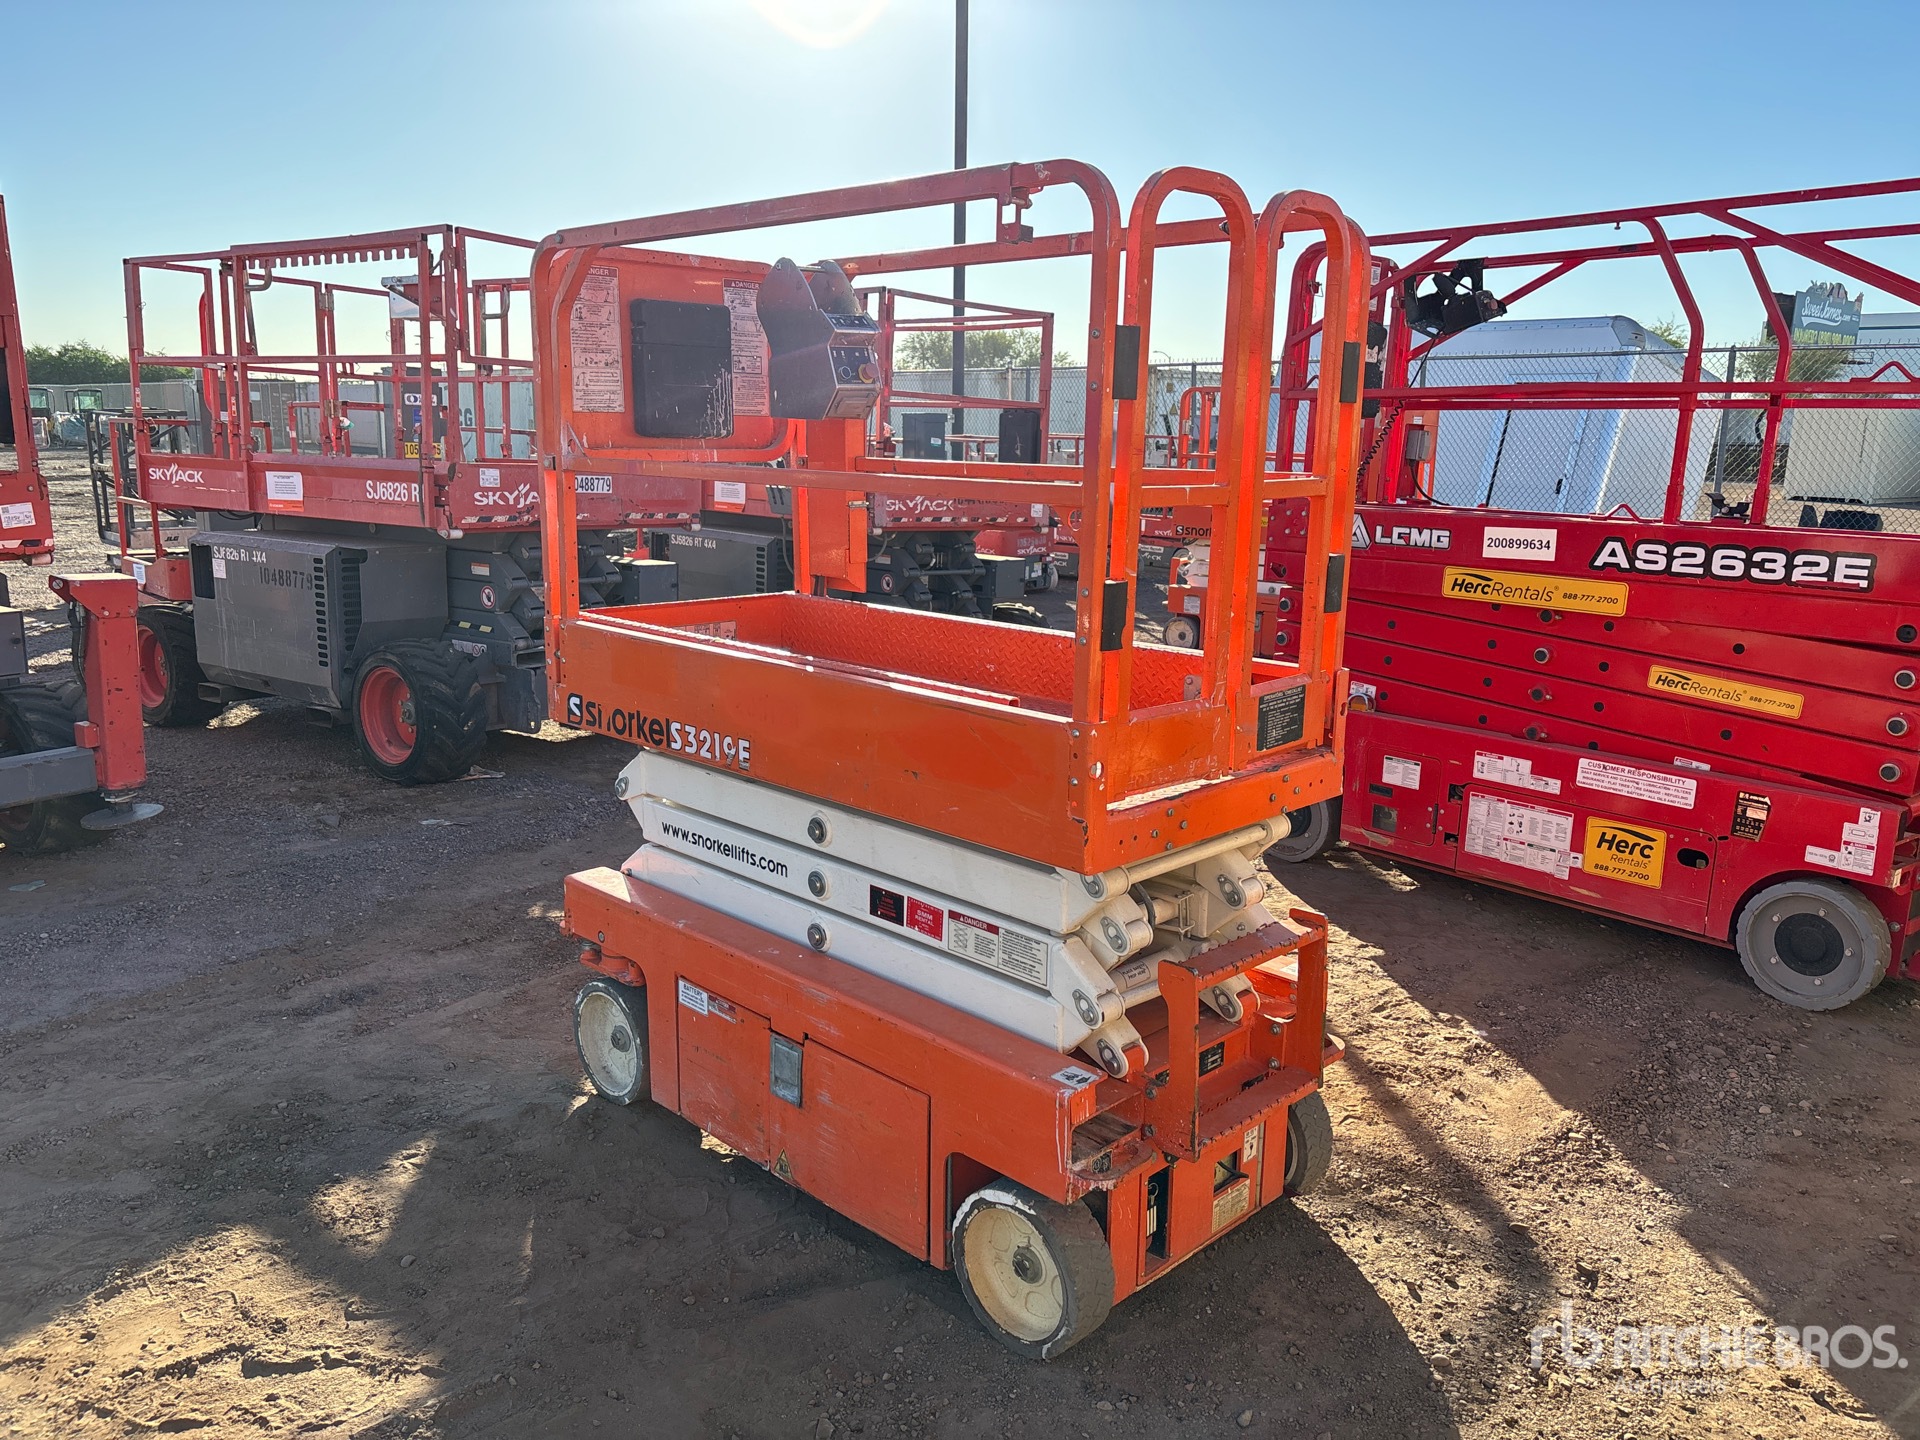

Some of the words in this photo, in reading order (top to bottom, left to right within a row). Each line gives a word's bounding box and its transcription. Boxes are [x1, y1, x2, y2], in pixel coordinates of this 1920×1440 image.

[149, 463, 204, 484] SKYJACK
[366, 480, 408, 502] SJ6826
[886, 496, 954, 514] SKYJACK
[694, 537, 702, 548] RT
[1375, 525, 1451, 549] LCMG
[1487, 537, 1551, 551] 200899634
[1591, 538, 1875, 590] AS2632E
[260, 567, 313, 591] 10488779
[1562, 592, 1619, 606] 888-777-2700
[1749, 695, 1795, 711] 888-777-2700
[1588, 761, 1626, 775] CUSTOMER
[1627, 768, 1687, 786] RESPONSIBILITY
[1593, 771, 1609, 779] SERVICE
[1674, 788, 1692, 796] FILTERS
[661, 821, 789, 878] www.snorkellifts.com
[1596, 831, 1654, 859] Herc
[1610, 854, 1649, 870] Rentals
[1594, 863, 1650, 881] 888-777-2700
[914, 915, 935, 927] RENTAL
[916, 909, 933, 921] SMM
[964, 917, 988, 931] DANGER
